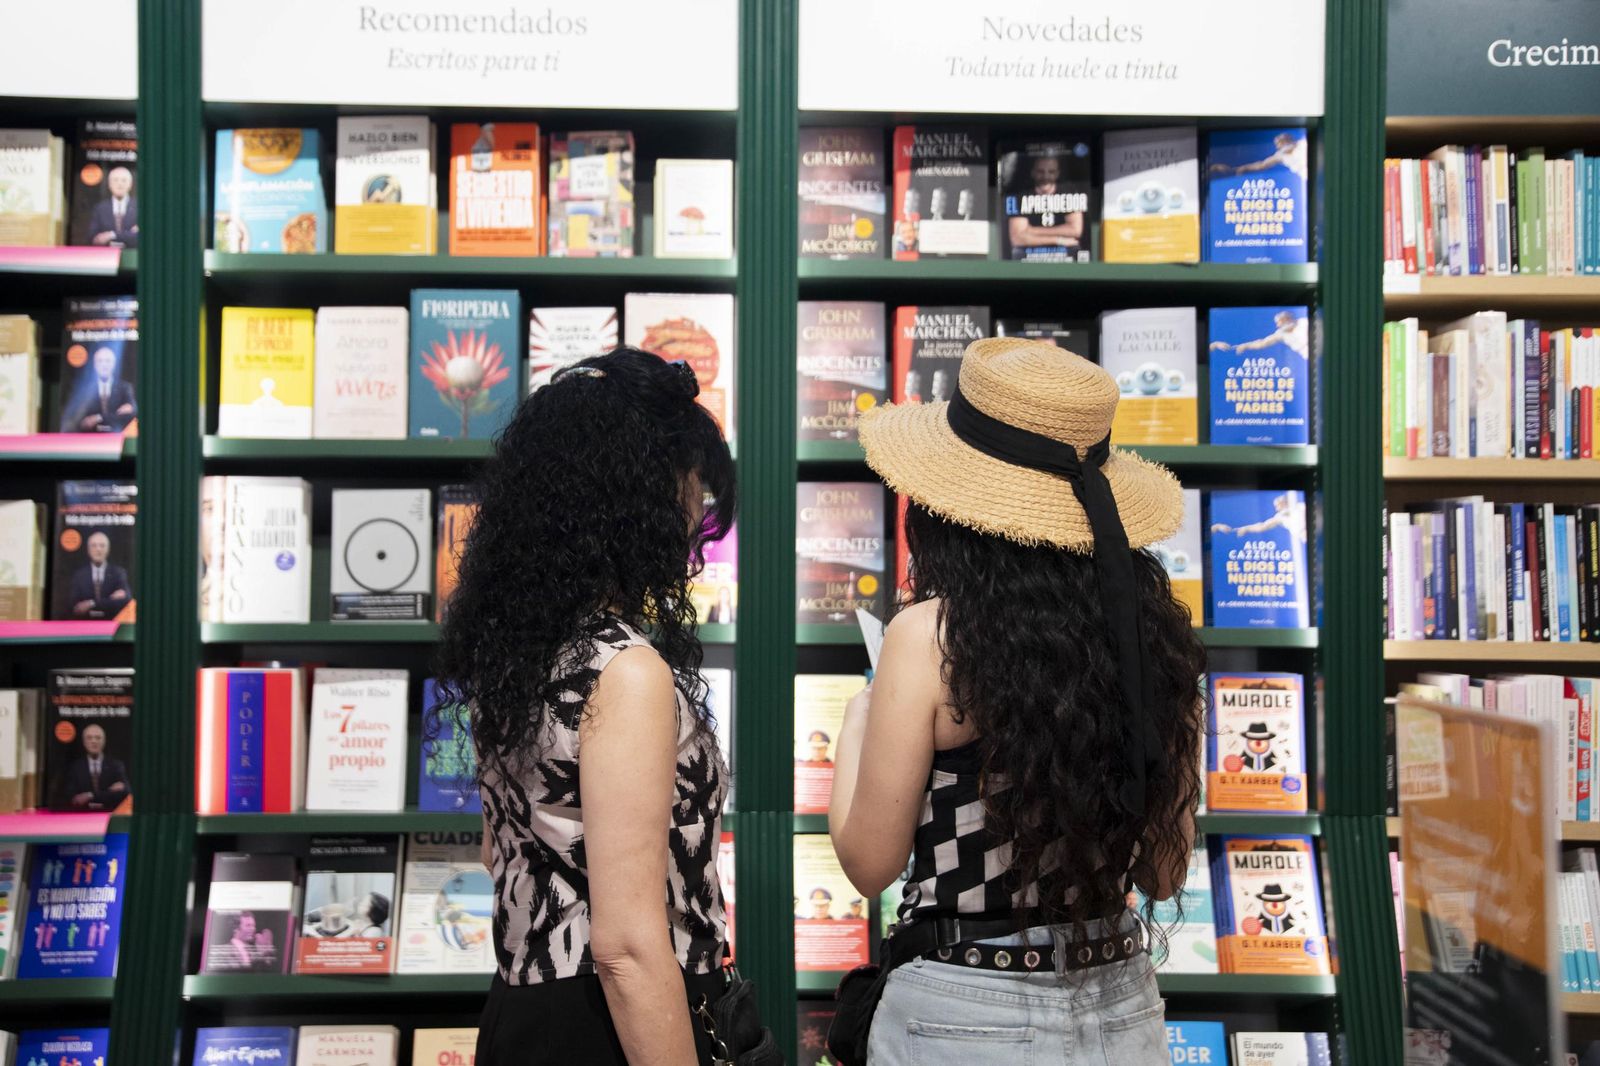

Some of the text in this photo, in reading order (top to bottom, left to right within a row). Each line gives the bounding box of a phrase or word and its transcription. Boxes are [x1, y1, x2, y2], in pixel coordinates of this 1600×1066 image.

[358, 5, 588, 36] Recomendados
[981, 15, 1144, 43] Novedades
[1487, 38, 1600, 67] Crecim
[387, 47, 560, 79] Escritos para ti
[945, 56, 1179, 80] Todavía huele a tinta
[912, 133, 972, 146] MANUEL
[902, 144, 982, 158] MARCHENA
[802, 151, 876, 167] GRISHAM
[1242, 178, 1275, 190] ALDO
[1227, 187, 1291, 200] CAZZULLO
[1005, 193, 1088, 216] EL APRENDEDOR
[1224, 198, 1294, 212] EL DIOS DE
[1225, 211, 1293, 224] NUESTROS
[1235, 223, 1284, 235] PADRES
[817, 309, 862, 325] JOHN
[913, 314, 973, 327] MANUEL
[802, 326, 876, 341] GRISHAM
[903, 326, 983, 340] MARCHENA
[1122, 330, 1177, 342] DANIEL
[1118, 342, 1182, 354] LACALLE
[1242, 357, 1276, 368] ALDO
[1227, 366, 1291, 377] CAZZULLO
[1224, 377, 1295, 391] EL DIOS DE
[1226, 390, 1294, 403] NUESTROS
[1235, 402, 1284, 415] PADRES
[816, 490, 859, 506] JOHN
[800, 508, 874, 523] GRISHAM
[1243, 541, 1276, 551] ALDO
[1229, 550, 1291, 561] CAZZULLO
[1226, 561, 1296, 573] EL DIOS DE
[1227, 573, 1294, 585] NUESTROS
[1237, 585, 1285, 597] PADRES
[330, 685, 391, 697] Walter Riso
[339, 704, 356, 733] 7
[351, 719, 391, 732] pilares
[340, 736, 387, 749] amor
[328, 751, 386, 771] propio
[1262, 939, 1301, 949] KARBER
[318, 1035, 375, 1043] MANUELA
[1244, 1040, 1284, 1049] El mundo
[316, 1048, 374, 1056] CARMENA
[1244, 1050, 1275, 1059] de ayer
